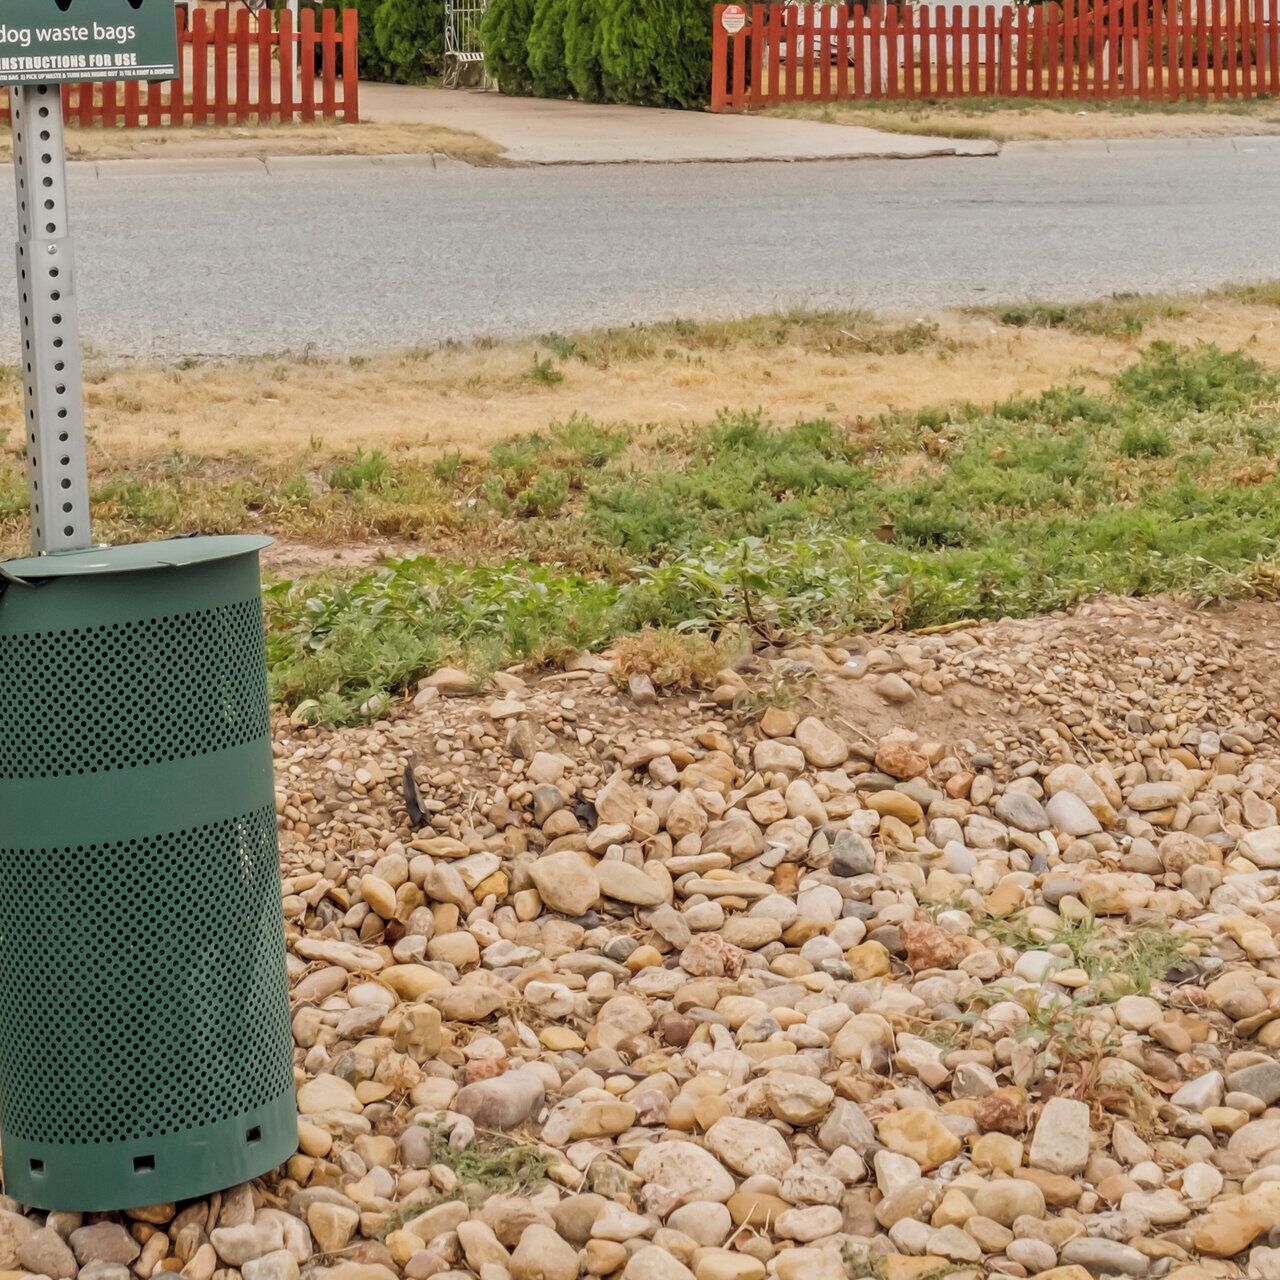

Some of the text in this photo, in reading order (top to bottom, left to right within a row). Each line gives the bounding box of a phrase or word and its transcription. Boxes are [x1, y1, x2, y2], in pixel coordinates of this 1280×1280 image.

[35, 25, 89, 42] waste
[93, 21, 136, 44] bags
[89, 54, 112, 67] FOR
[114, 53, 137, 66] USE
